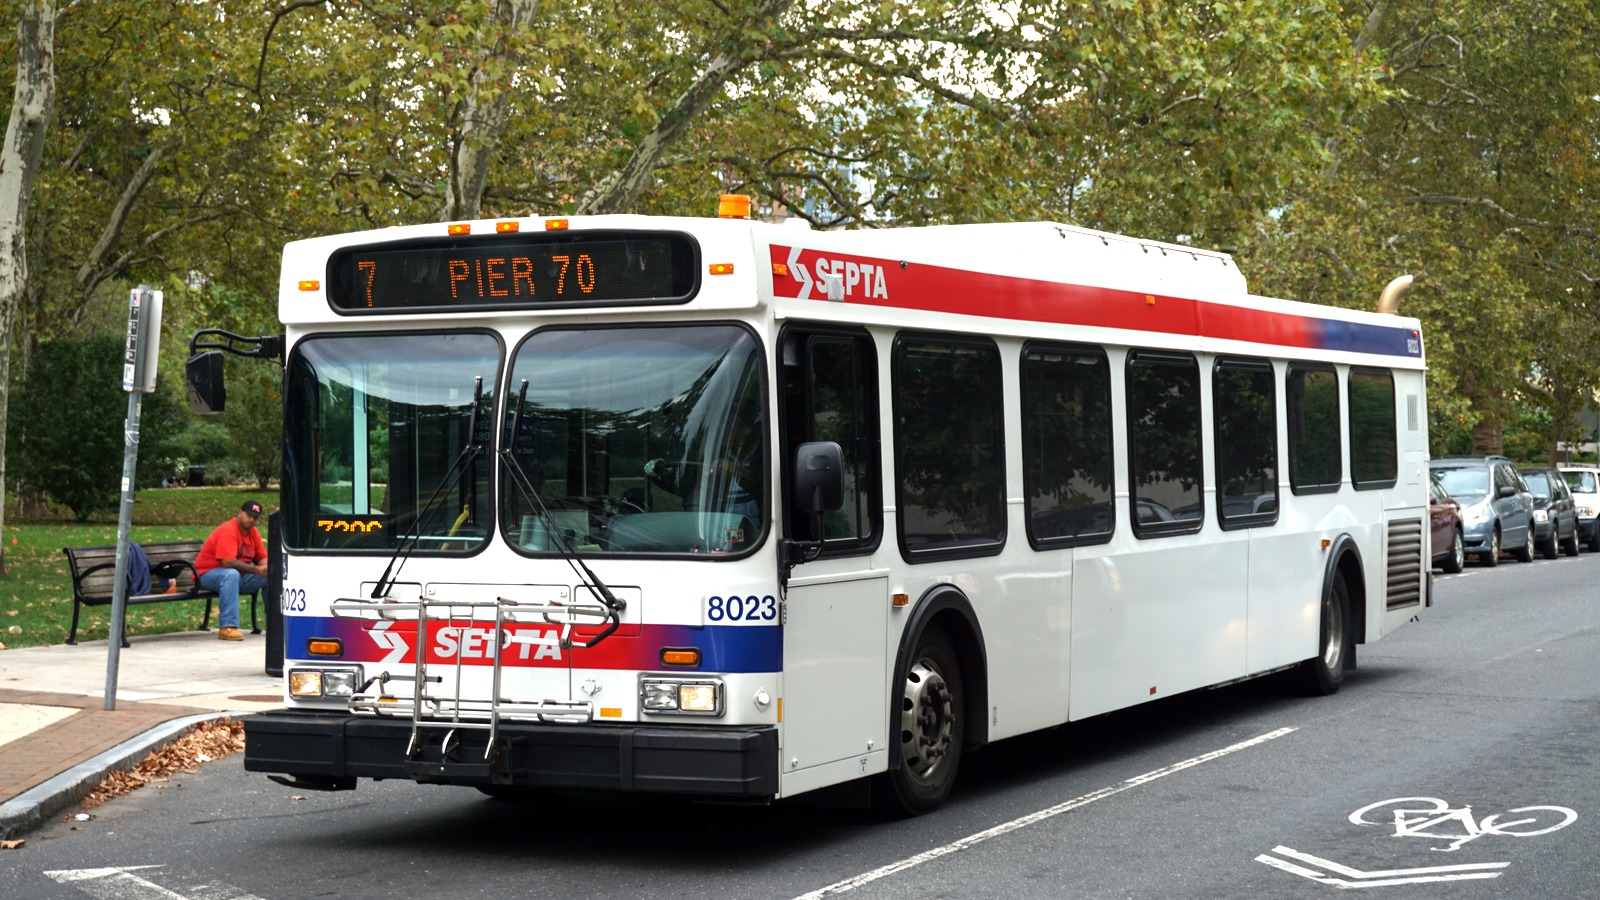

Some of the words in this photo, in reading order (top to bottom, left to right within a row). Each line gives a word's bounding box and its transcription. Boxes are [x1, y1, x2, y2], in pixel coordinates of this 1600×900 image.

[358, 261, 376, 307] 7
[449, 257, 535, 298] PIER
[552, 254, 595, 294] 70
[815, 257, 888, 299] SEPTA
[708, 595, 777, 621] 8023
[434, 626, 562, 661] SEPTA
